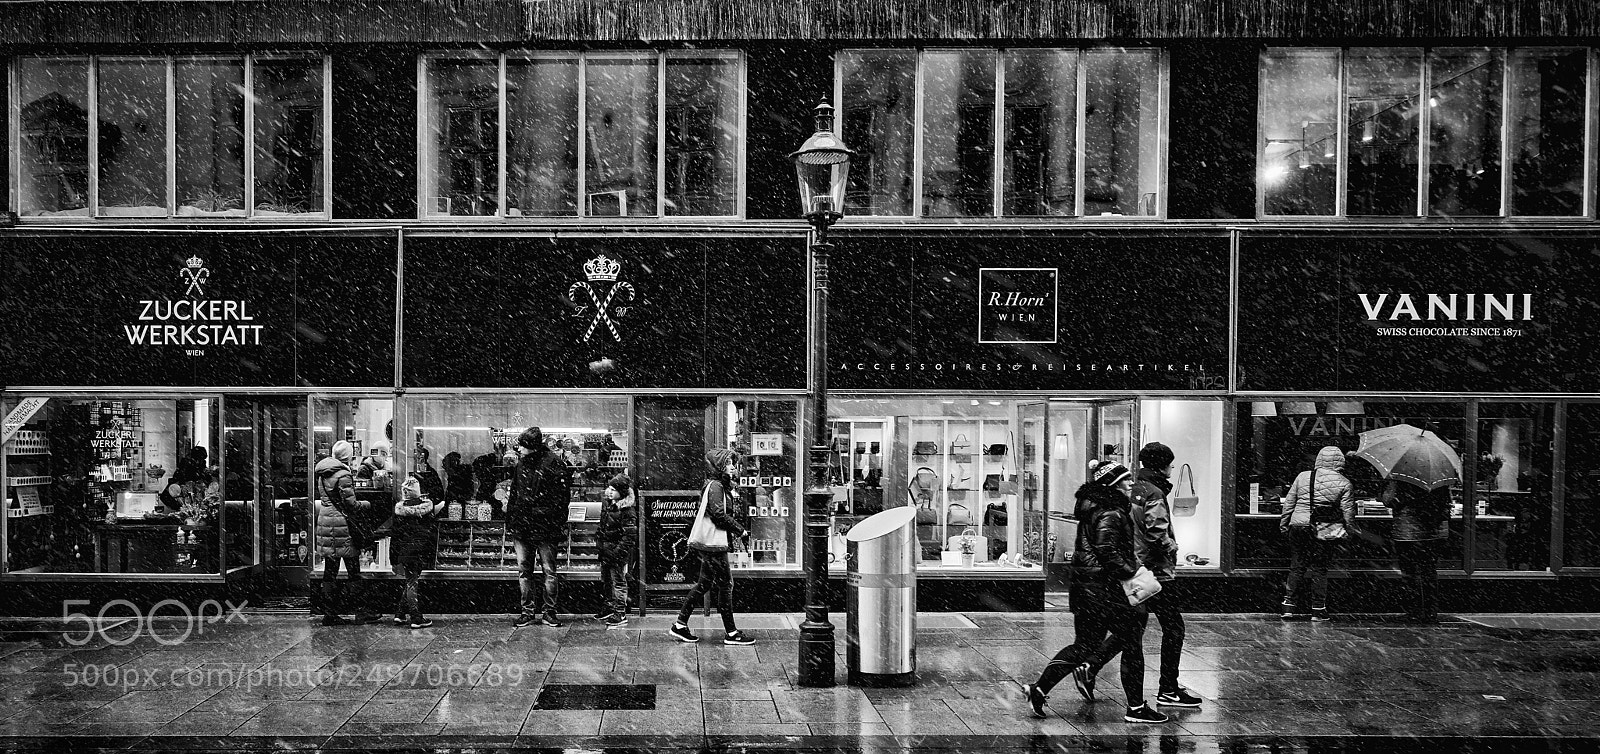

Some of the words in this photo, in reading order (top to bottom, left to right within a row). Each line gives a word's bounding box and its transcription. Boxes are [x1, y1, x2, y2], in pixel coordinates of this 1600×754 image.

[138, 300, 254, 321] ZUCKERL
[1357, 293, 1532, 321] VANINI
[998, 313, 1035, 322] WIEN
[123, 325, 264, 345] WERKSTATT
[1376, 327, 1407, 337] SWISS
[1408, 327, 1469, 337] CHOCOLATE
[1470, 327, 1501, 337] SINCE
[1502, 328, 1522, 338] 1871
[185, 349, 205, 357] WIEN
